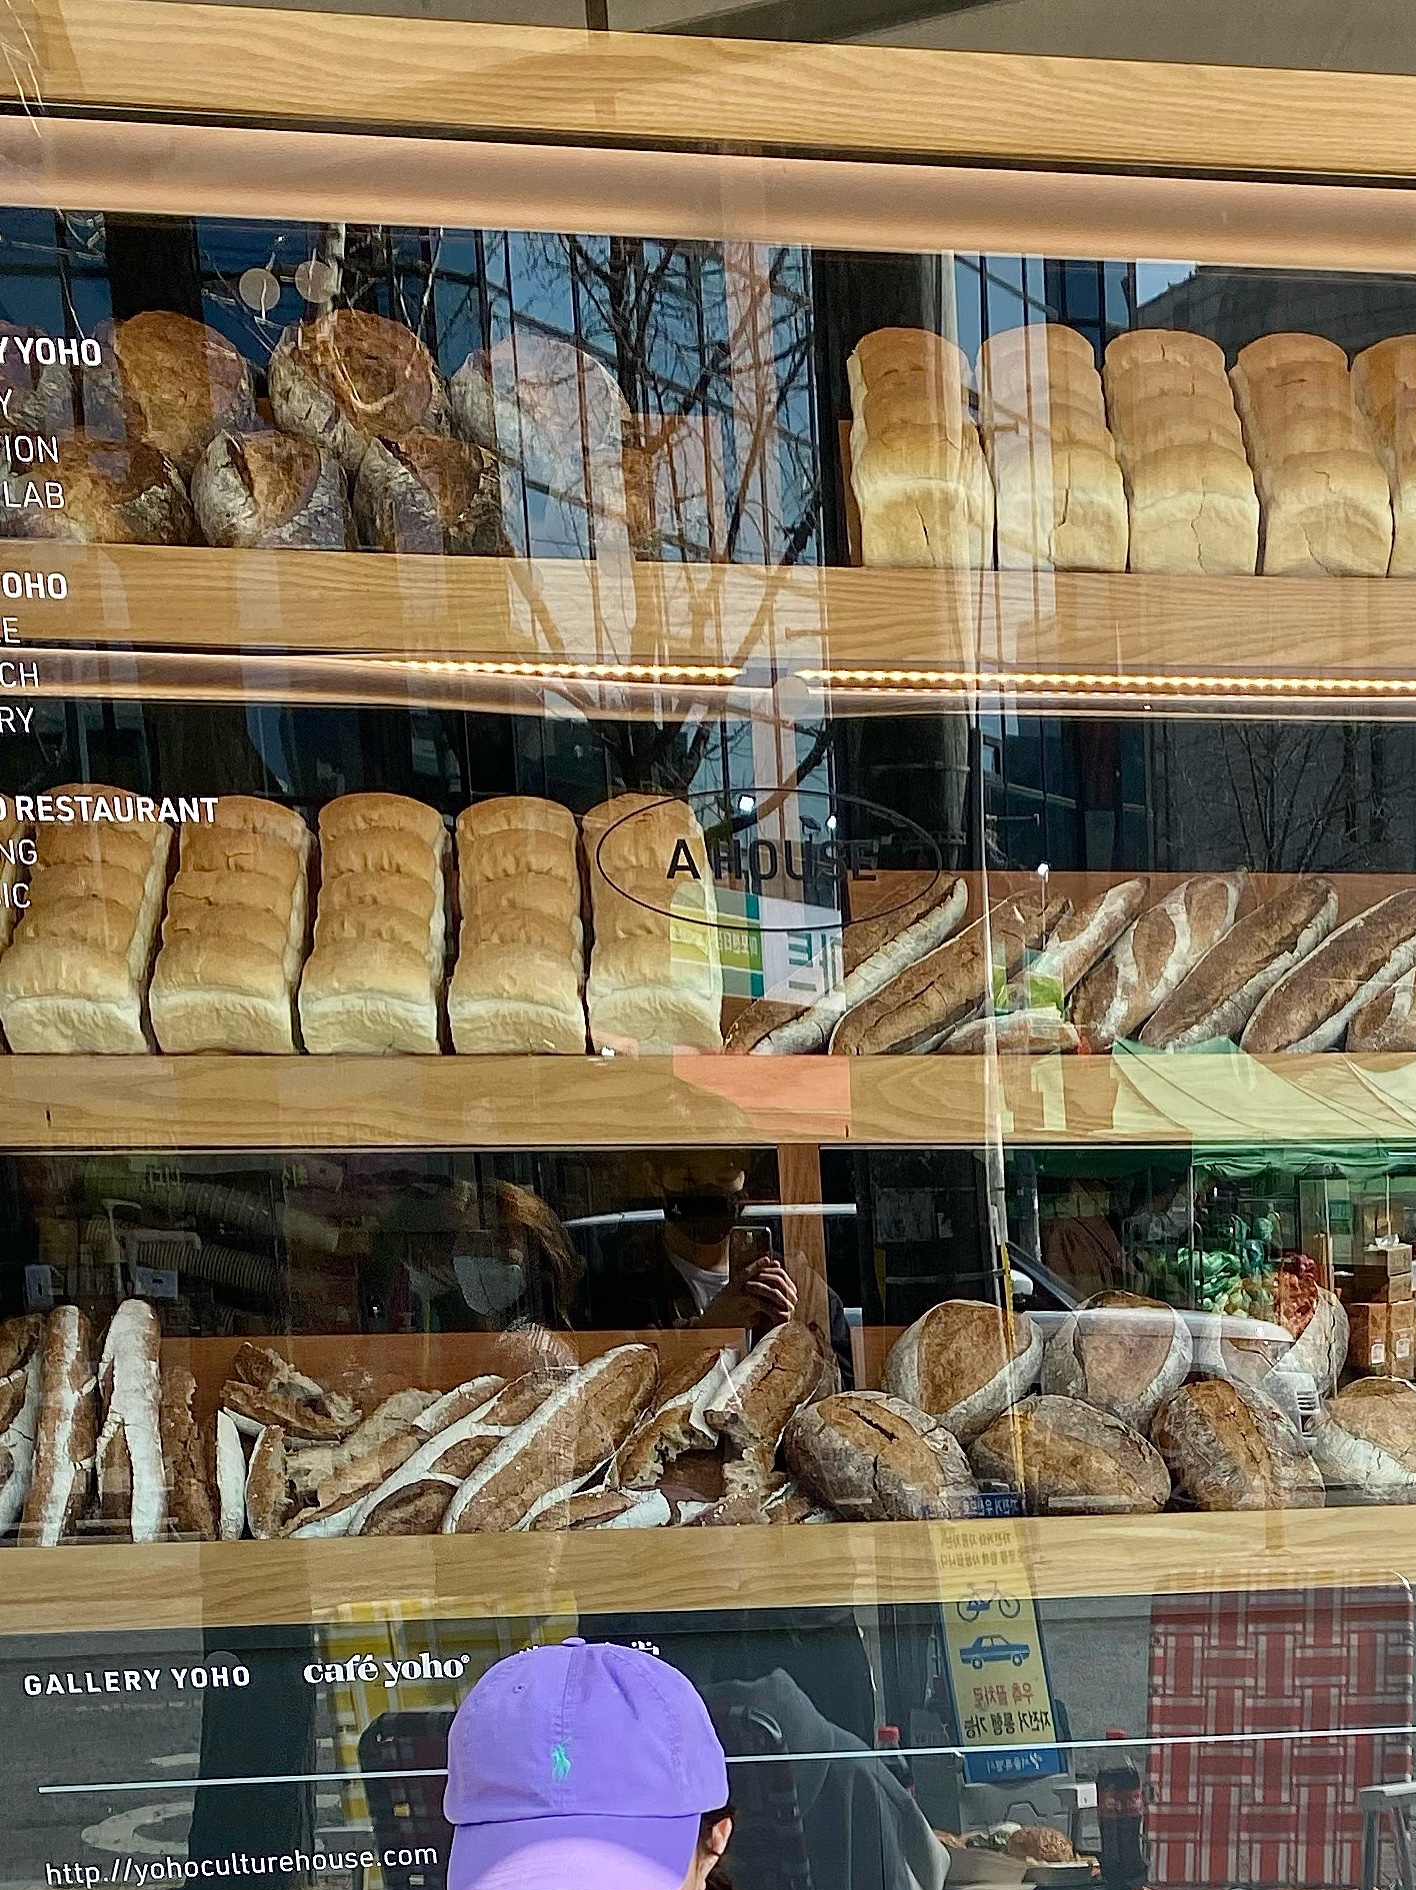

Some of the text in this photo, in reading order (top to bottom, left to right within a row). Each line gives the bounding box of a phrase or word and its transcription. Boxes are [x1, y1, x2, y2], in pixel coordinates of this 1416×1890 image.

[15, 337, 102, 366] YOHO
[0, 434, 59, 463] ION
[3, 480, 65, 509] LAB
[0, 572, 68, 599] OHO
[16, 795, 218, 823] RESTAURANT
[667, 838, 878, 882] A HOUSE
[24, 1664, 251, 1697] GALLERY YOHO
[303, 1655, 379, 1685] café
